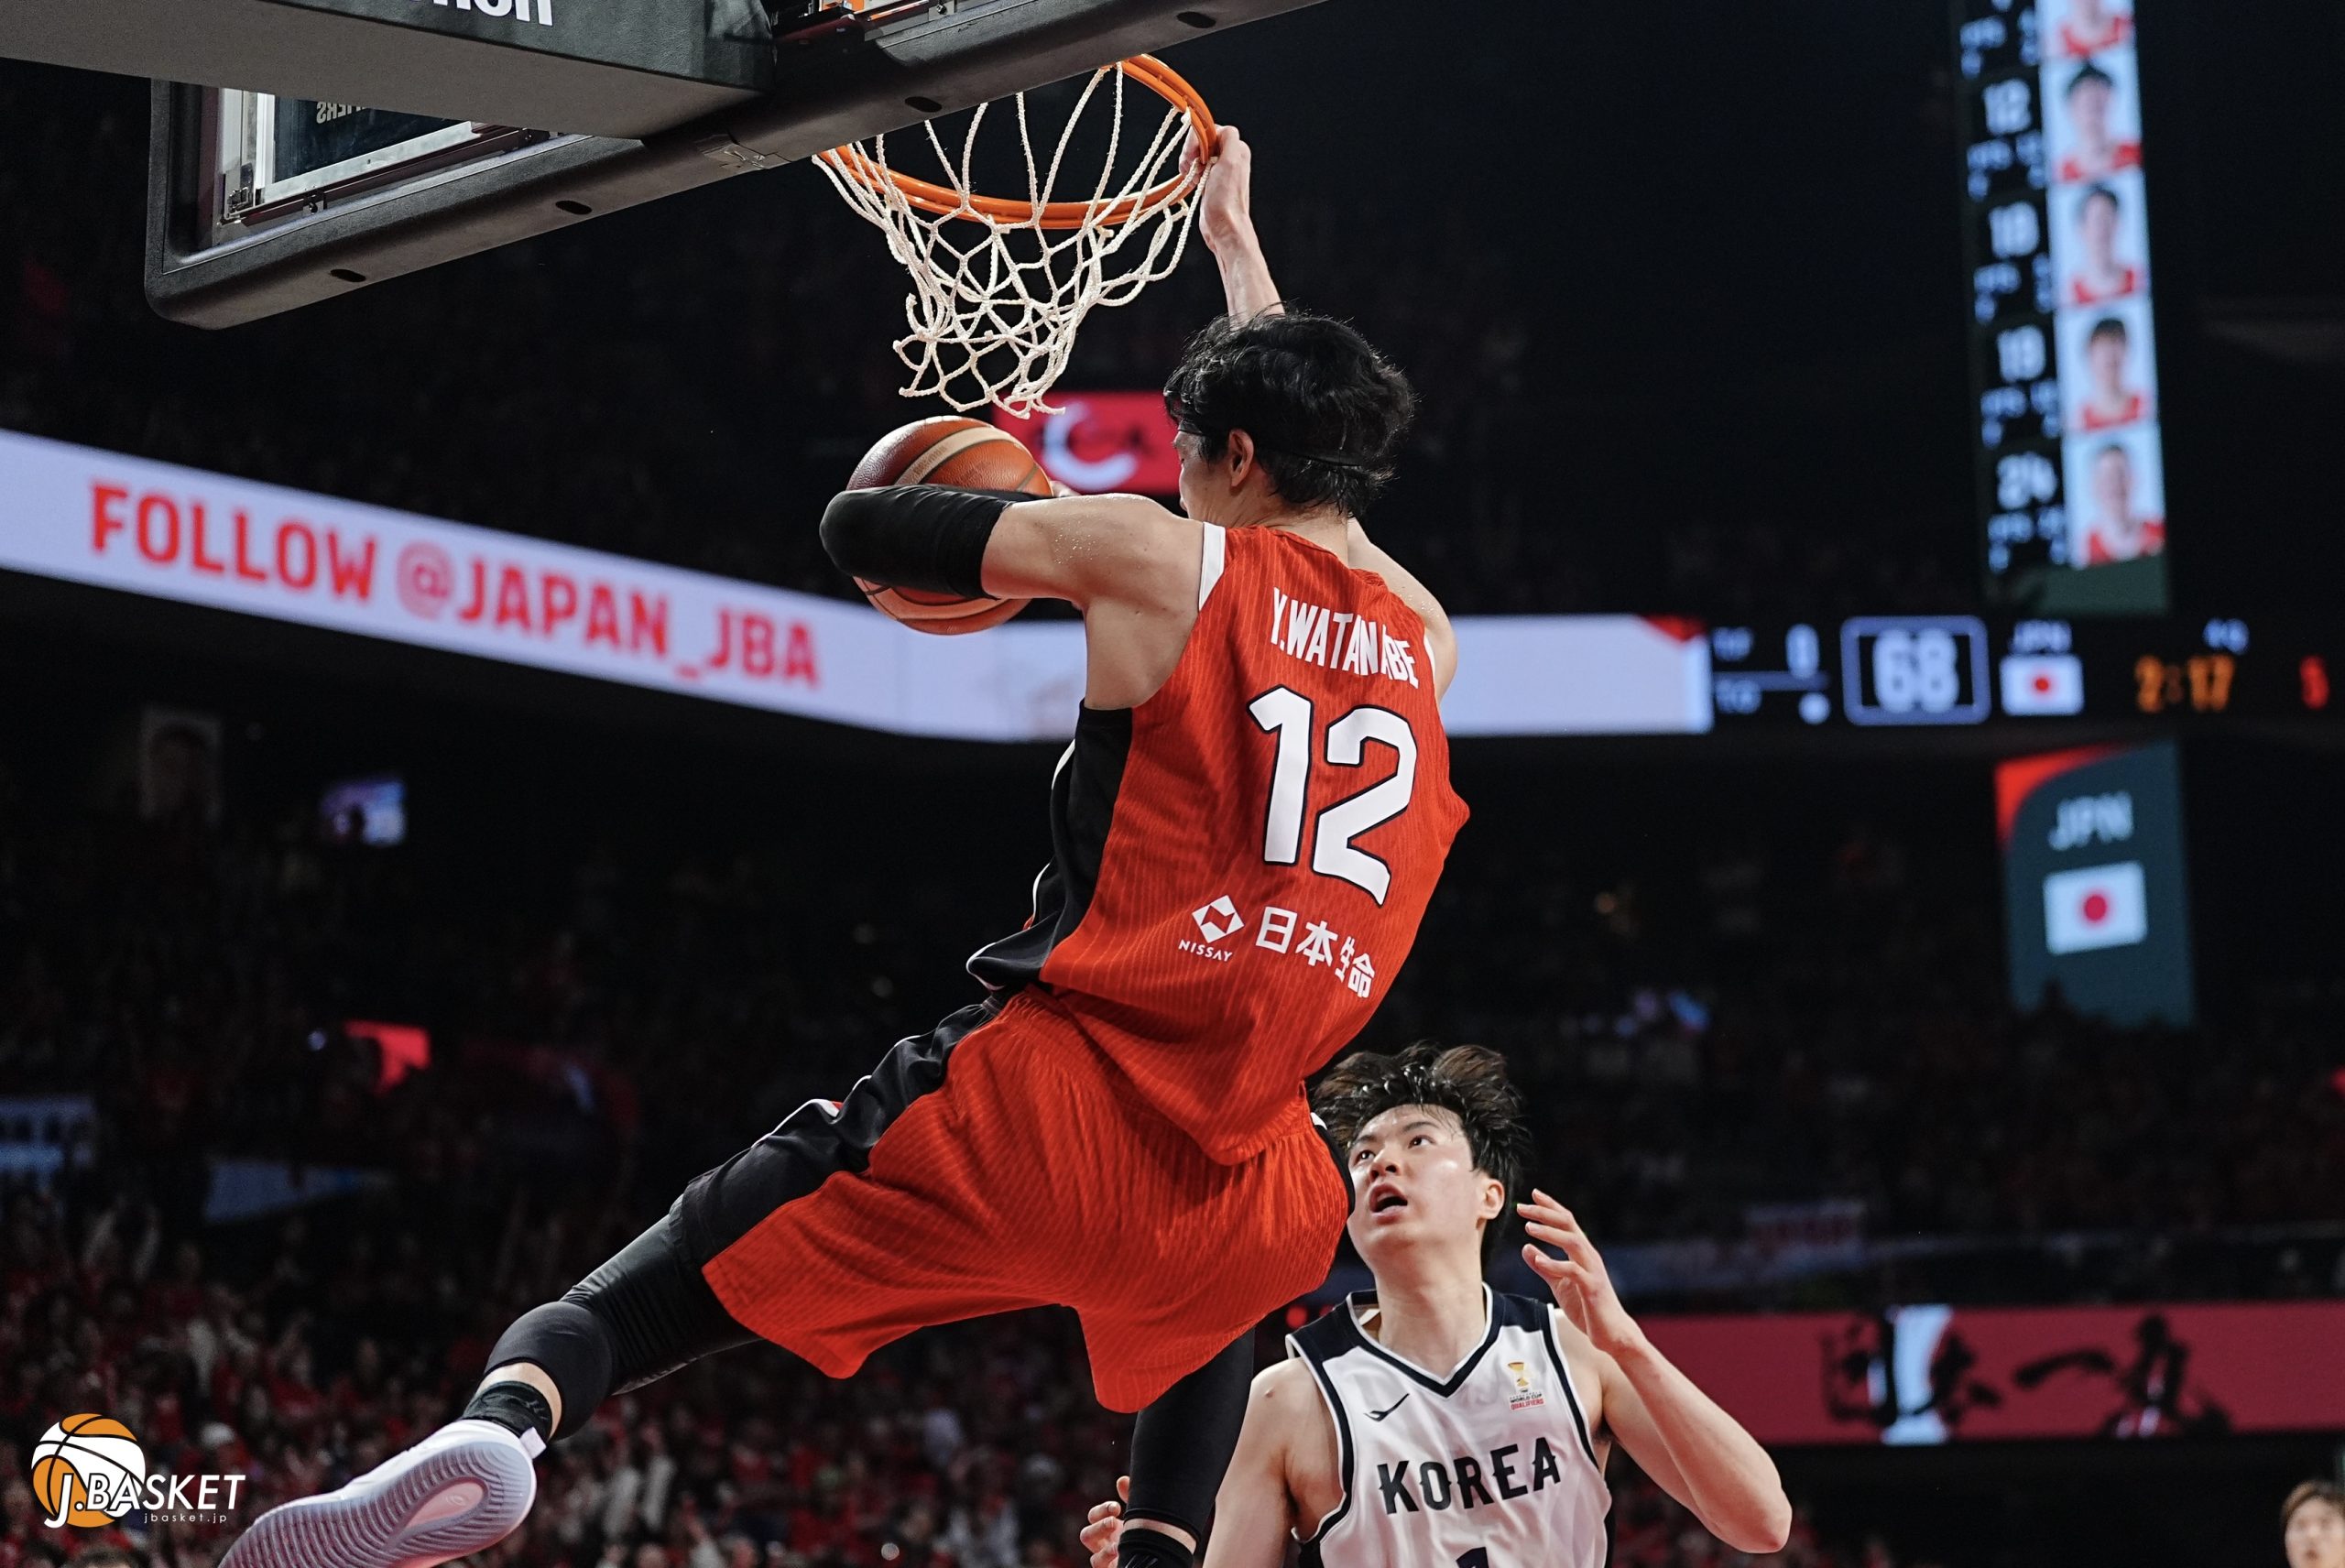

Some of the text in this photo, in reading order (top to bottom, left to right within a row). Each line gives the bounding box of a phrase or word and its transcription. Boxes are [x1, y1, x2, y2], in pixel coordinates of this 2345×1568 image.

[93, 484, 818, 687] FOLLOW @JAPAN_JBA
[1271, 586, 1419, 689] Y.WATANABE
[1872, 627, 1958, 713] 68
[2134, 655, 2235, 713] 2:17
[1247, 684, 1418, 908] 12
[2047, 790, 2133, 851] JPN
[1178, 939, 1232, 962] NISSAY
[1255, 906, 1375, 998] 日本生命
[1377, 1437, 1561, 1515] KOREA
